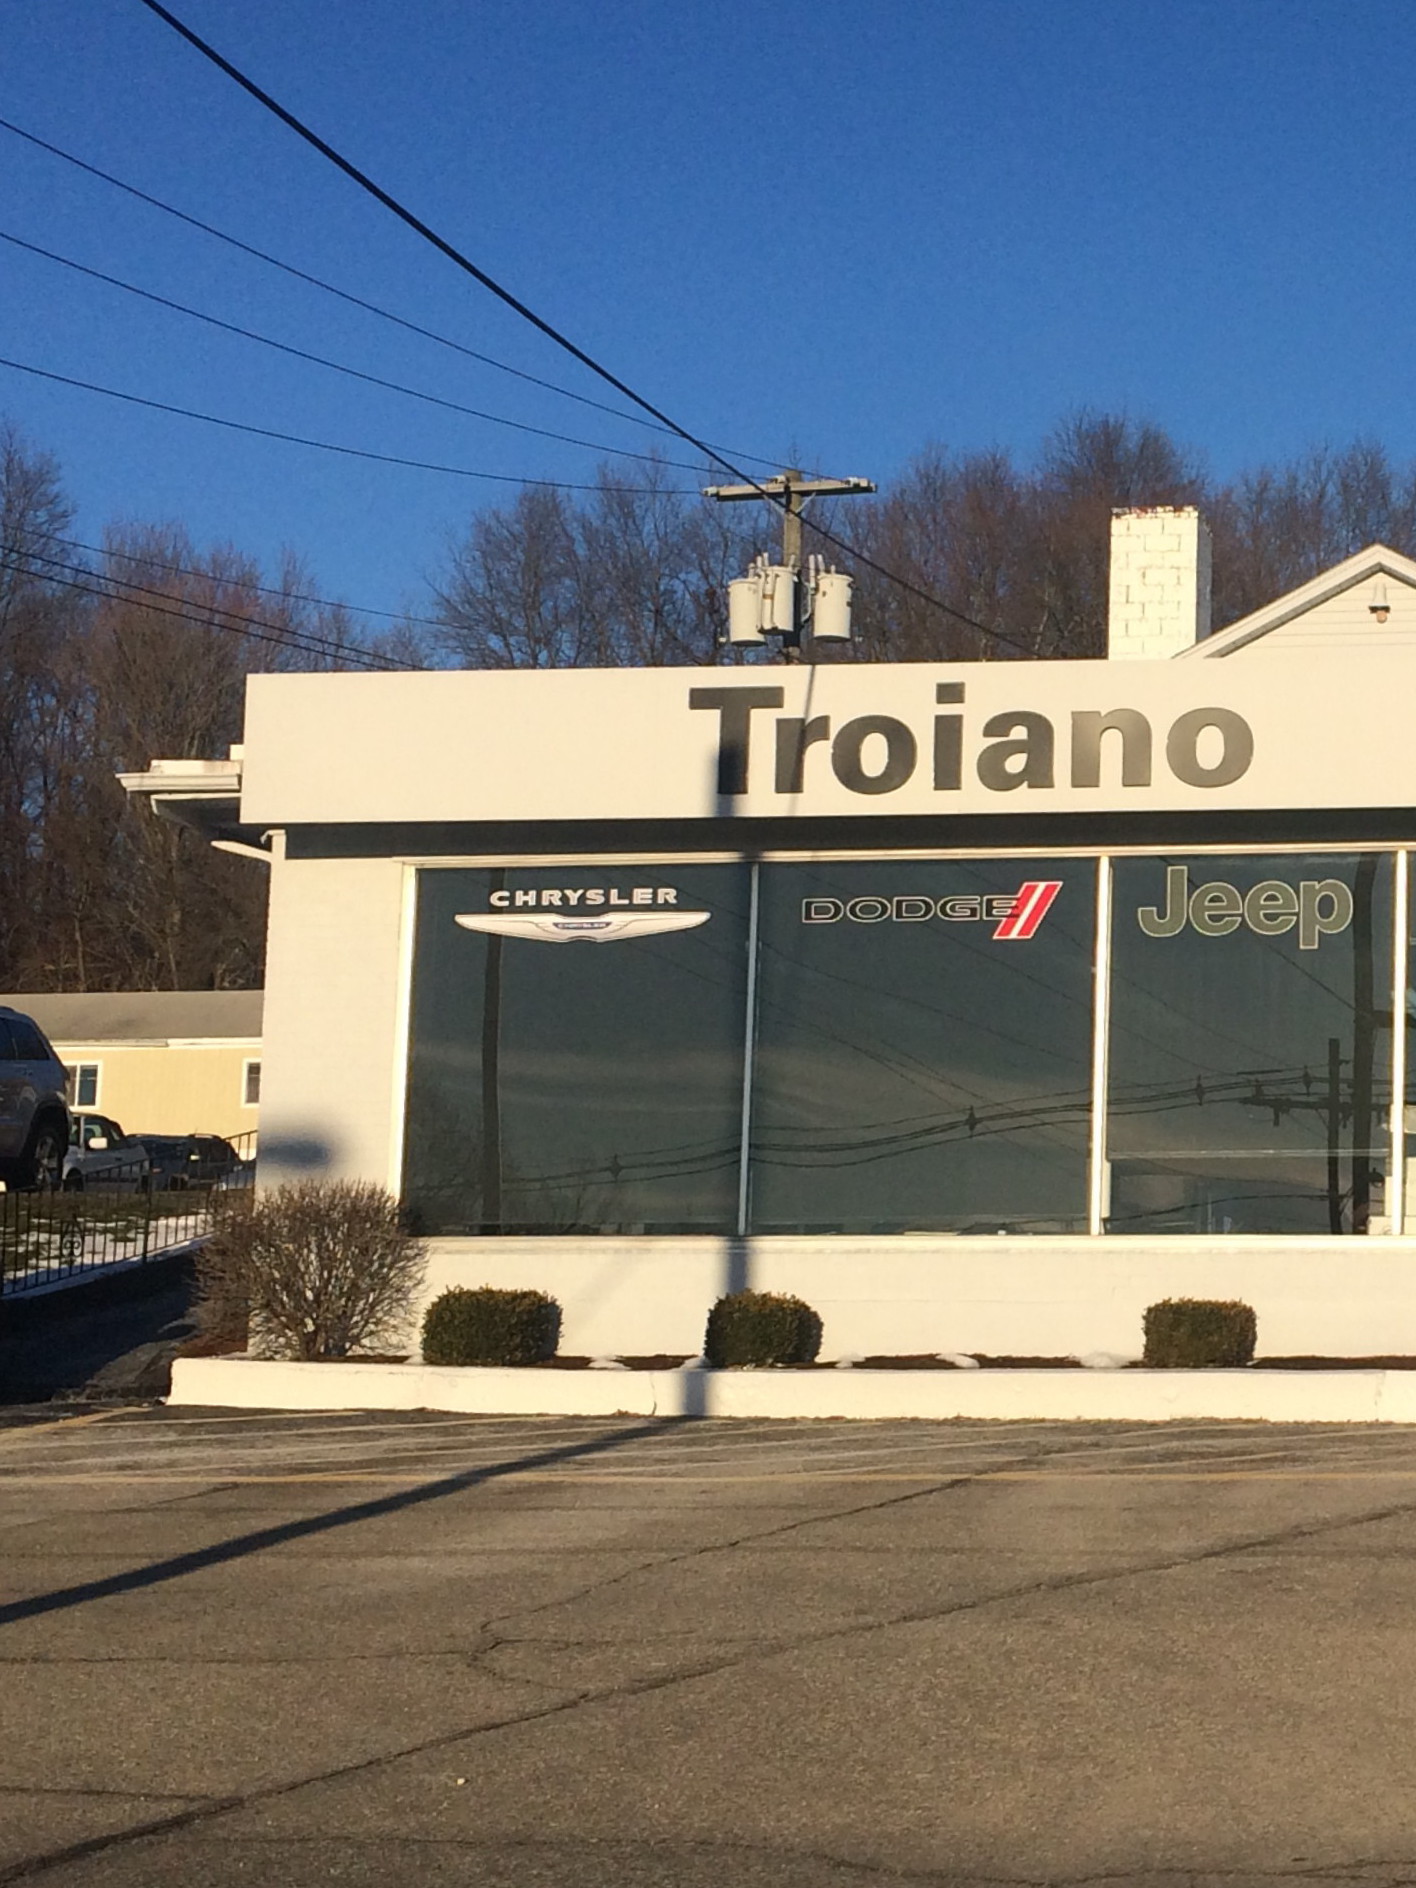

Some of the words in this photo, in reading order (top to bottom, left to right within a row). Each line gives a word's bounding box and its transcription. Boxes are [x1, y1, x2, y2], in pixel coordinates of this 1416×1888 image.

[688, 681, 1254, 796] Troiano
[489, 887, 678, 907] CHRYSLER
[802, 896, 1020, 924] DODGE
[1137, 864, 1354, 950] Jeep
